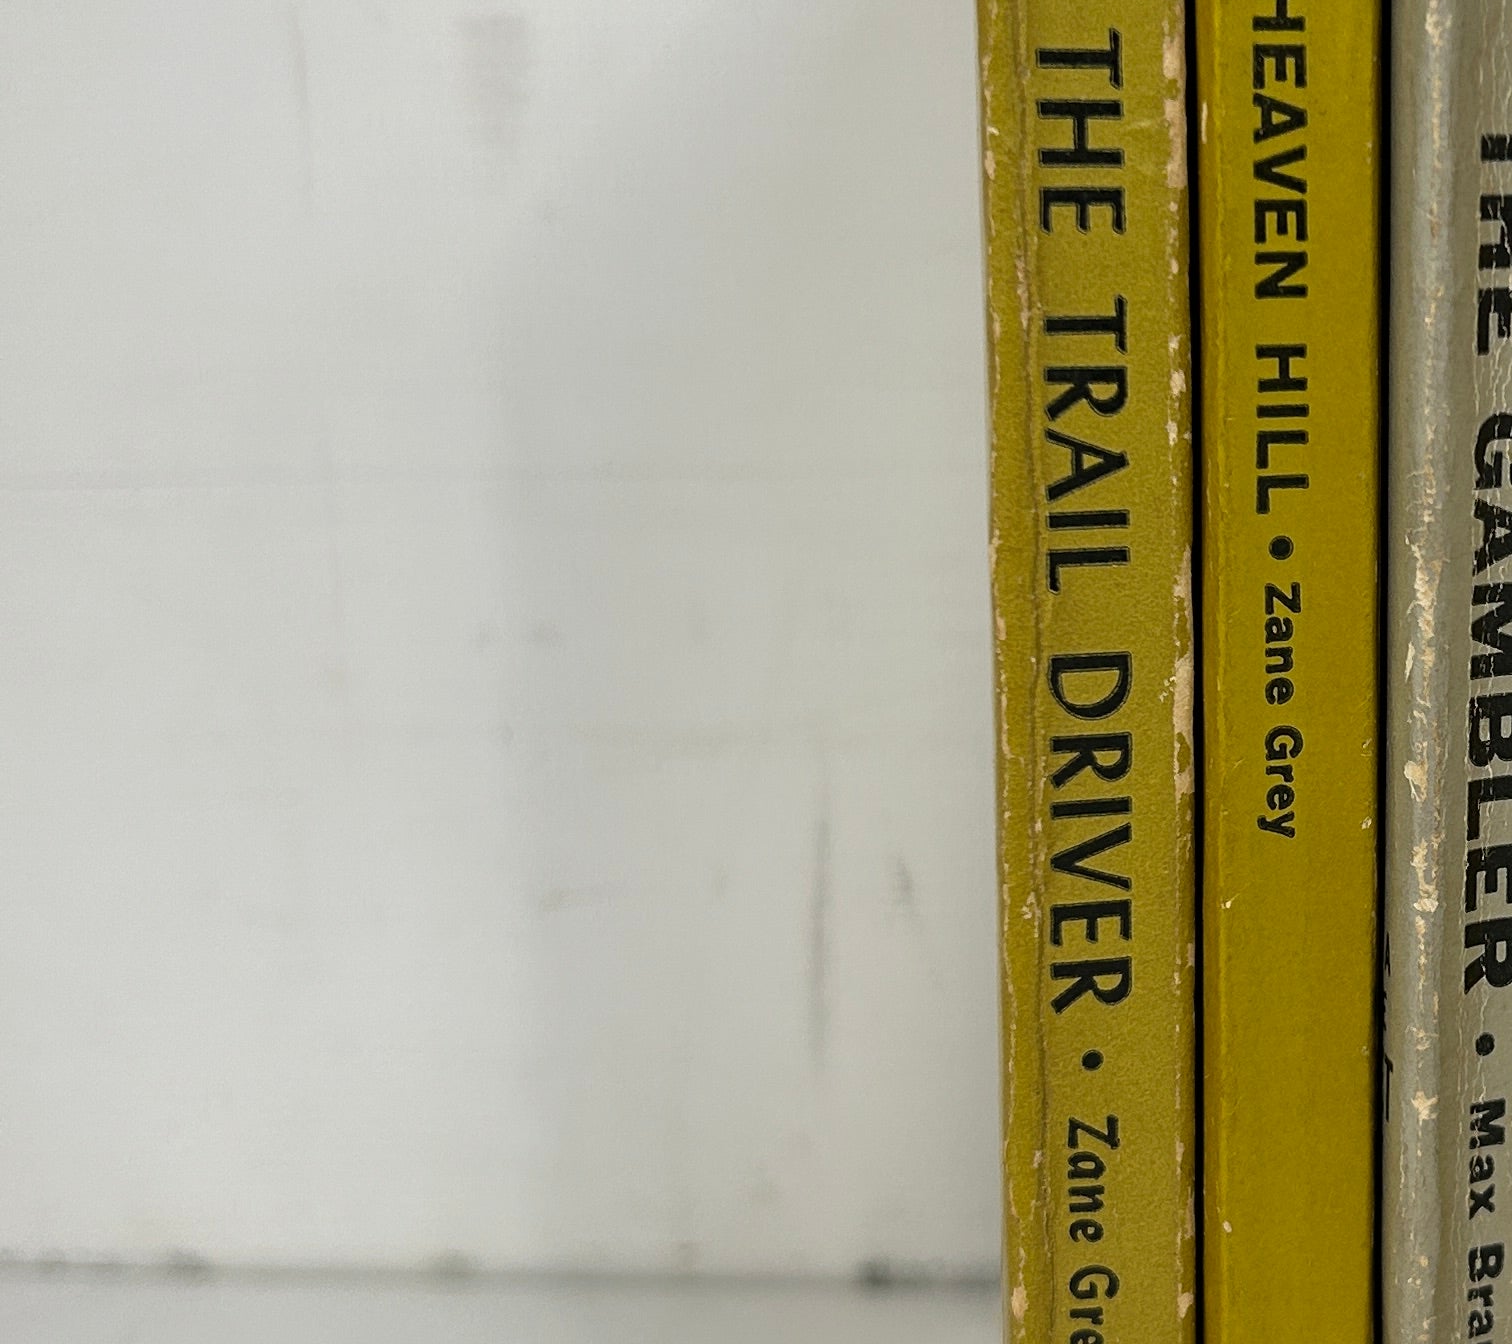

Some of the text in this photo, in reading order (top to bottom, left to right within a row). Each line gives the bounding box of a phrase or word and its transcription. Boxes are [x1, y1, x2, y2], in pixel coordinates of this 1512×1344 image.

[1034, 27, 1127, 235] THE
[1042, 296, 1131, 596] TRAIL
[1254, 343, 1309, 515] HILL
[1263, 582, 1302, 706] Zane
[1046, 652, 1132, 1015] DRIVER
[1256, 725, 1303, 839] Grey
[1066, 1114, 1120, 1244] Zane
[1468, 1098, 1506, 1220] Max
